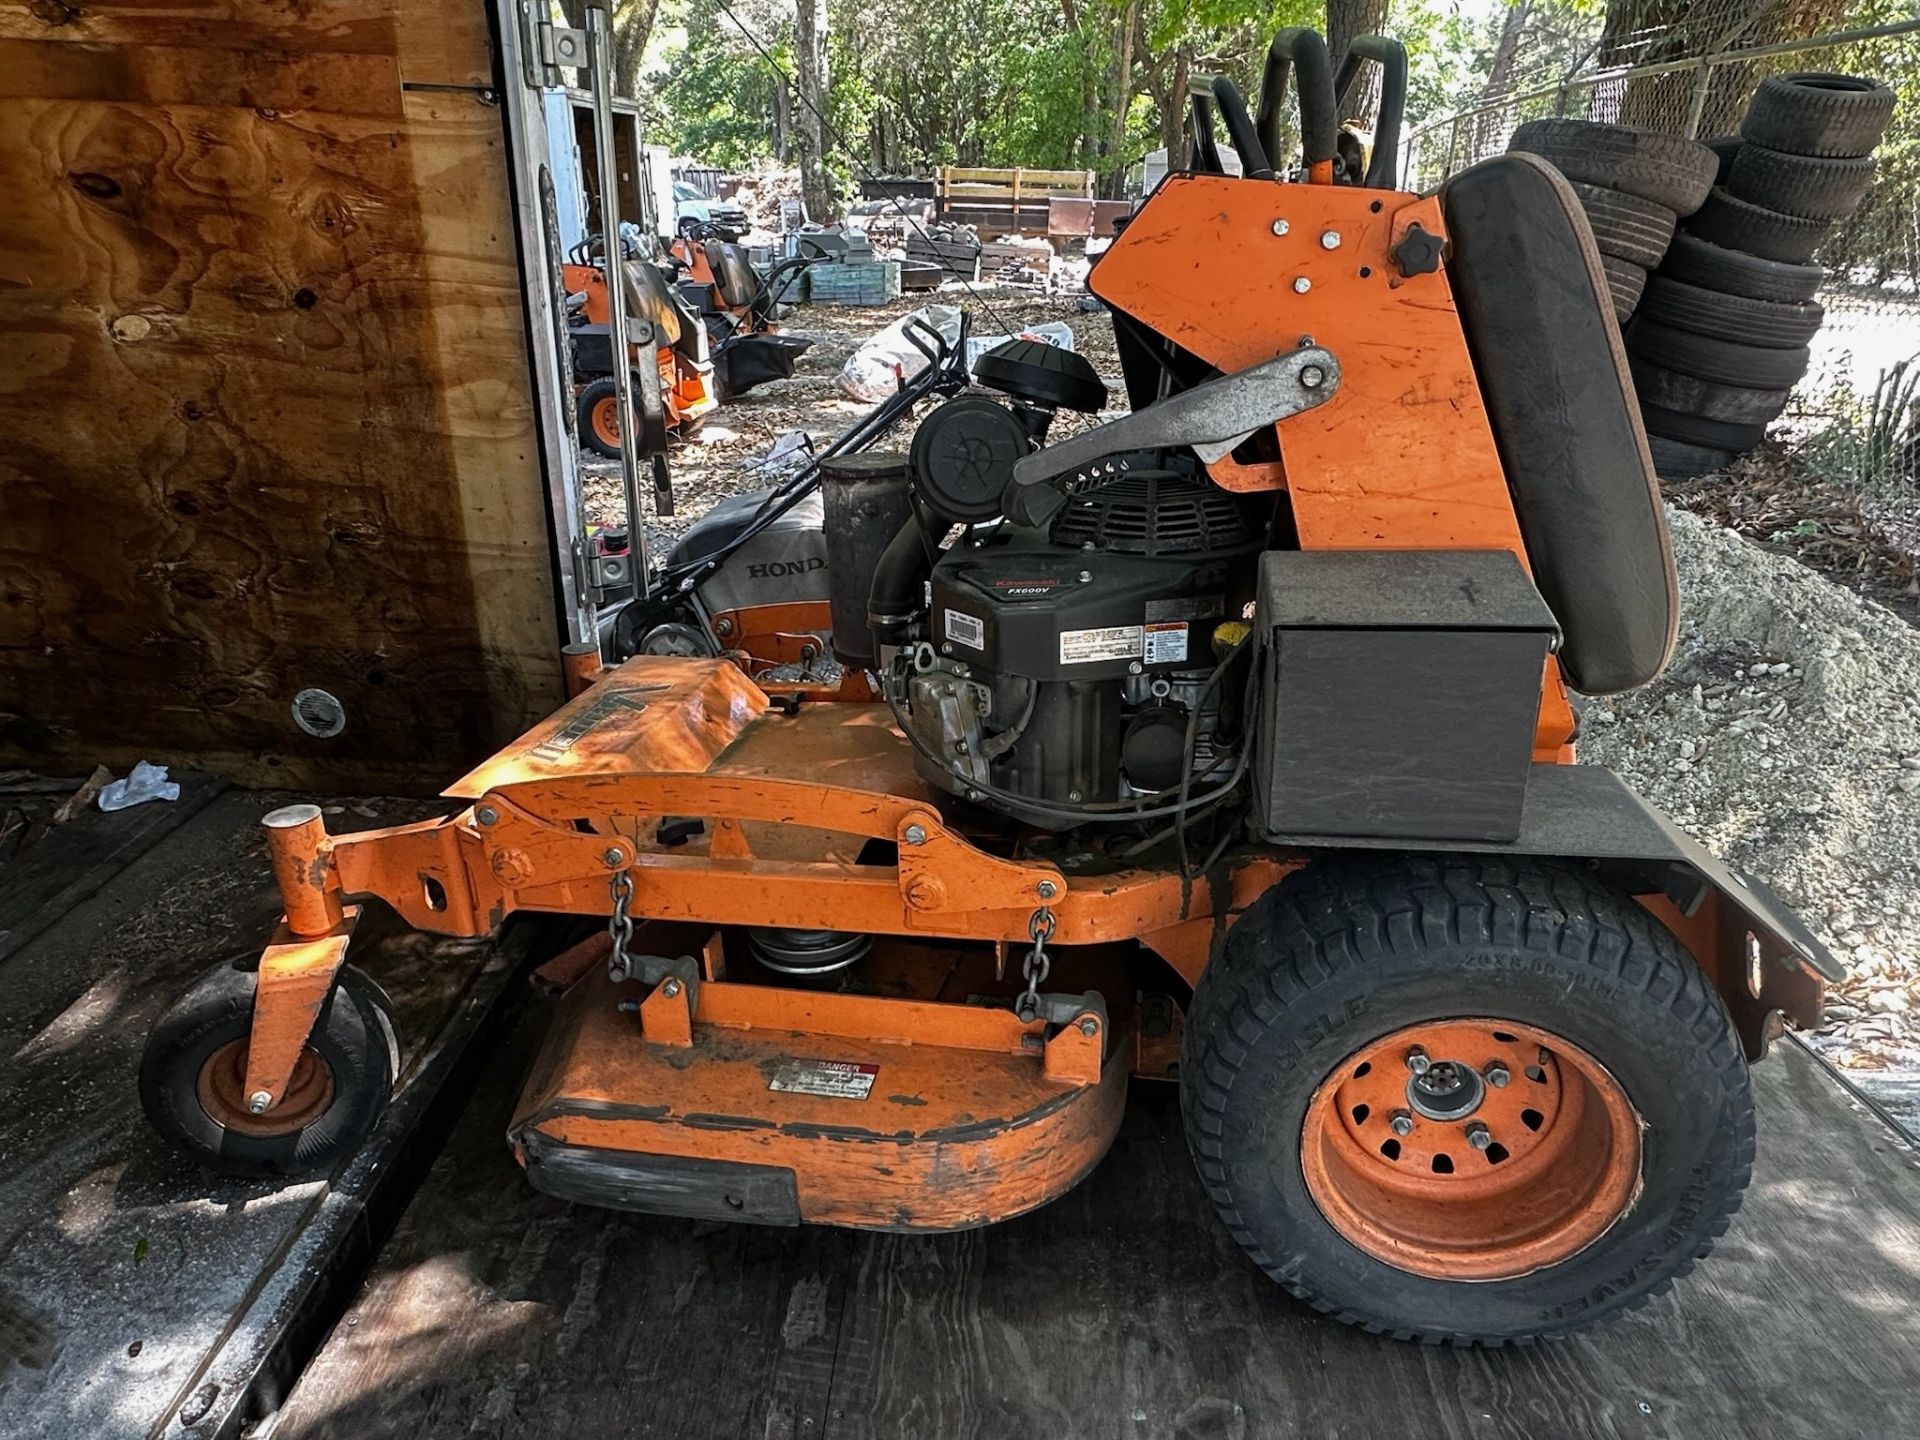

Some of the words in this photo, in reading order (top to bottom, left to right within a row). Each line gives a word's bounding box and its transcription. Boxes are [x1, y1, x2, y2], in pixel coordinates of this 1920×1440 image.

[747, 557, 828, 579] HOND
[1007, 587, 1050, 595] FX600V
[818, 1061, 861, 1073] DANGER
